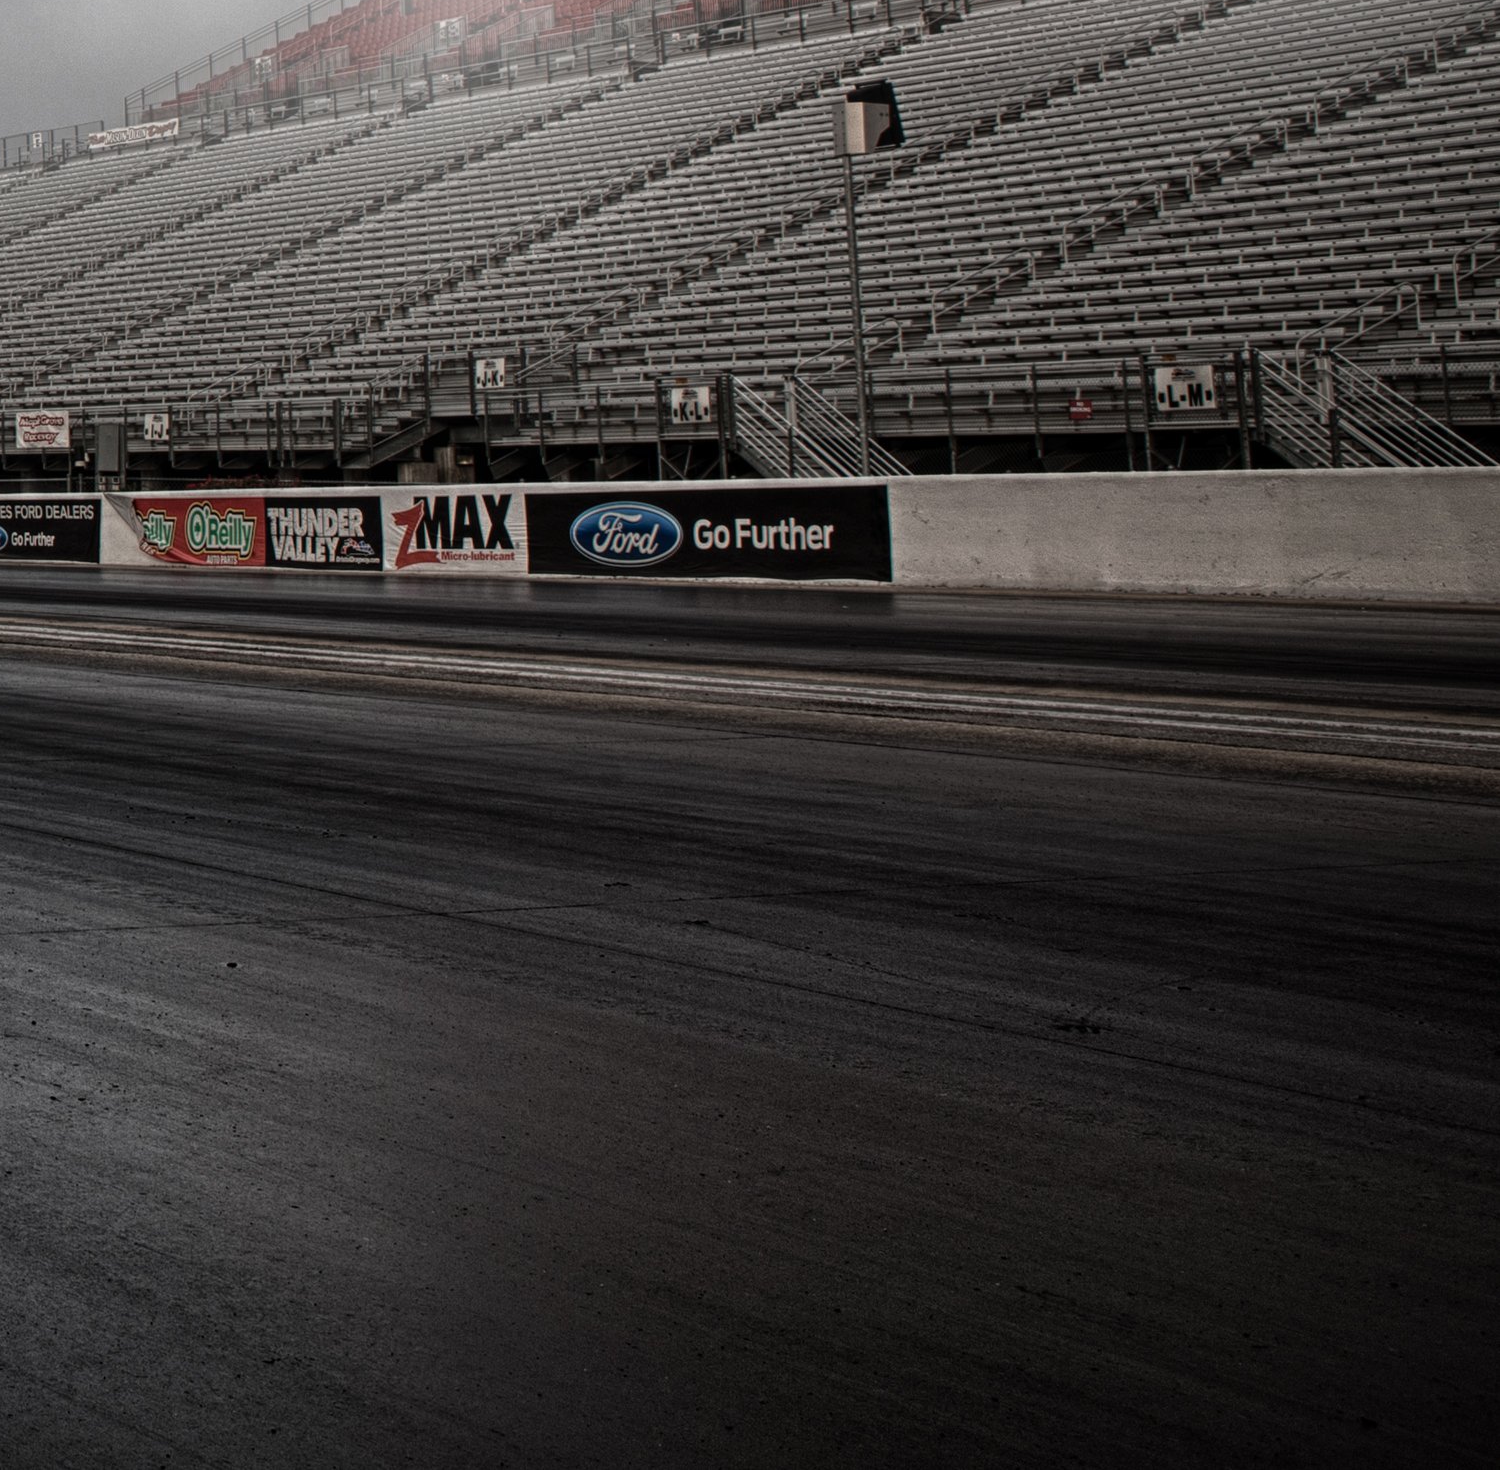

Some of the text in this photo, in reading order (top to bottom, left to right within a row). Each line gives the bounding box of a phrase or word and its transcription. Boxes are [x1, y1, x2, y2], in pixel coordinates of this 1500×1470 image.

[15, 505, 43, 519] FORD
[45, 505, 94, 520] DEALERS
[267, 508, 364, 537] THUNDER
[11, 532, 23, 547] Go
[24, 531, 55, 547] Further
[188, 505, 254, 556] O'Reilly
[593, 512, 834, 554] Ford Go Further
[206, 555, 238, 565] AUTO PARTS
[271, 536, 341, 563] VALLEY
[441, 550, 515, 561] Micro-lubricant
